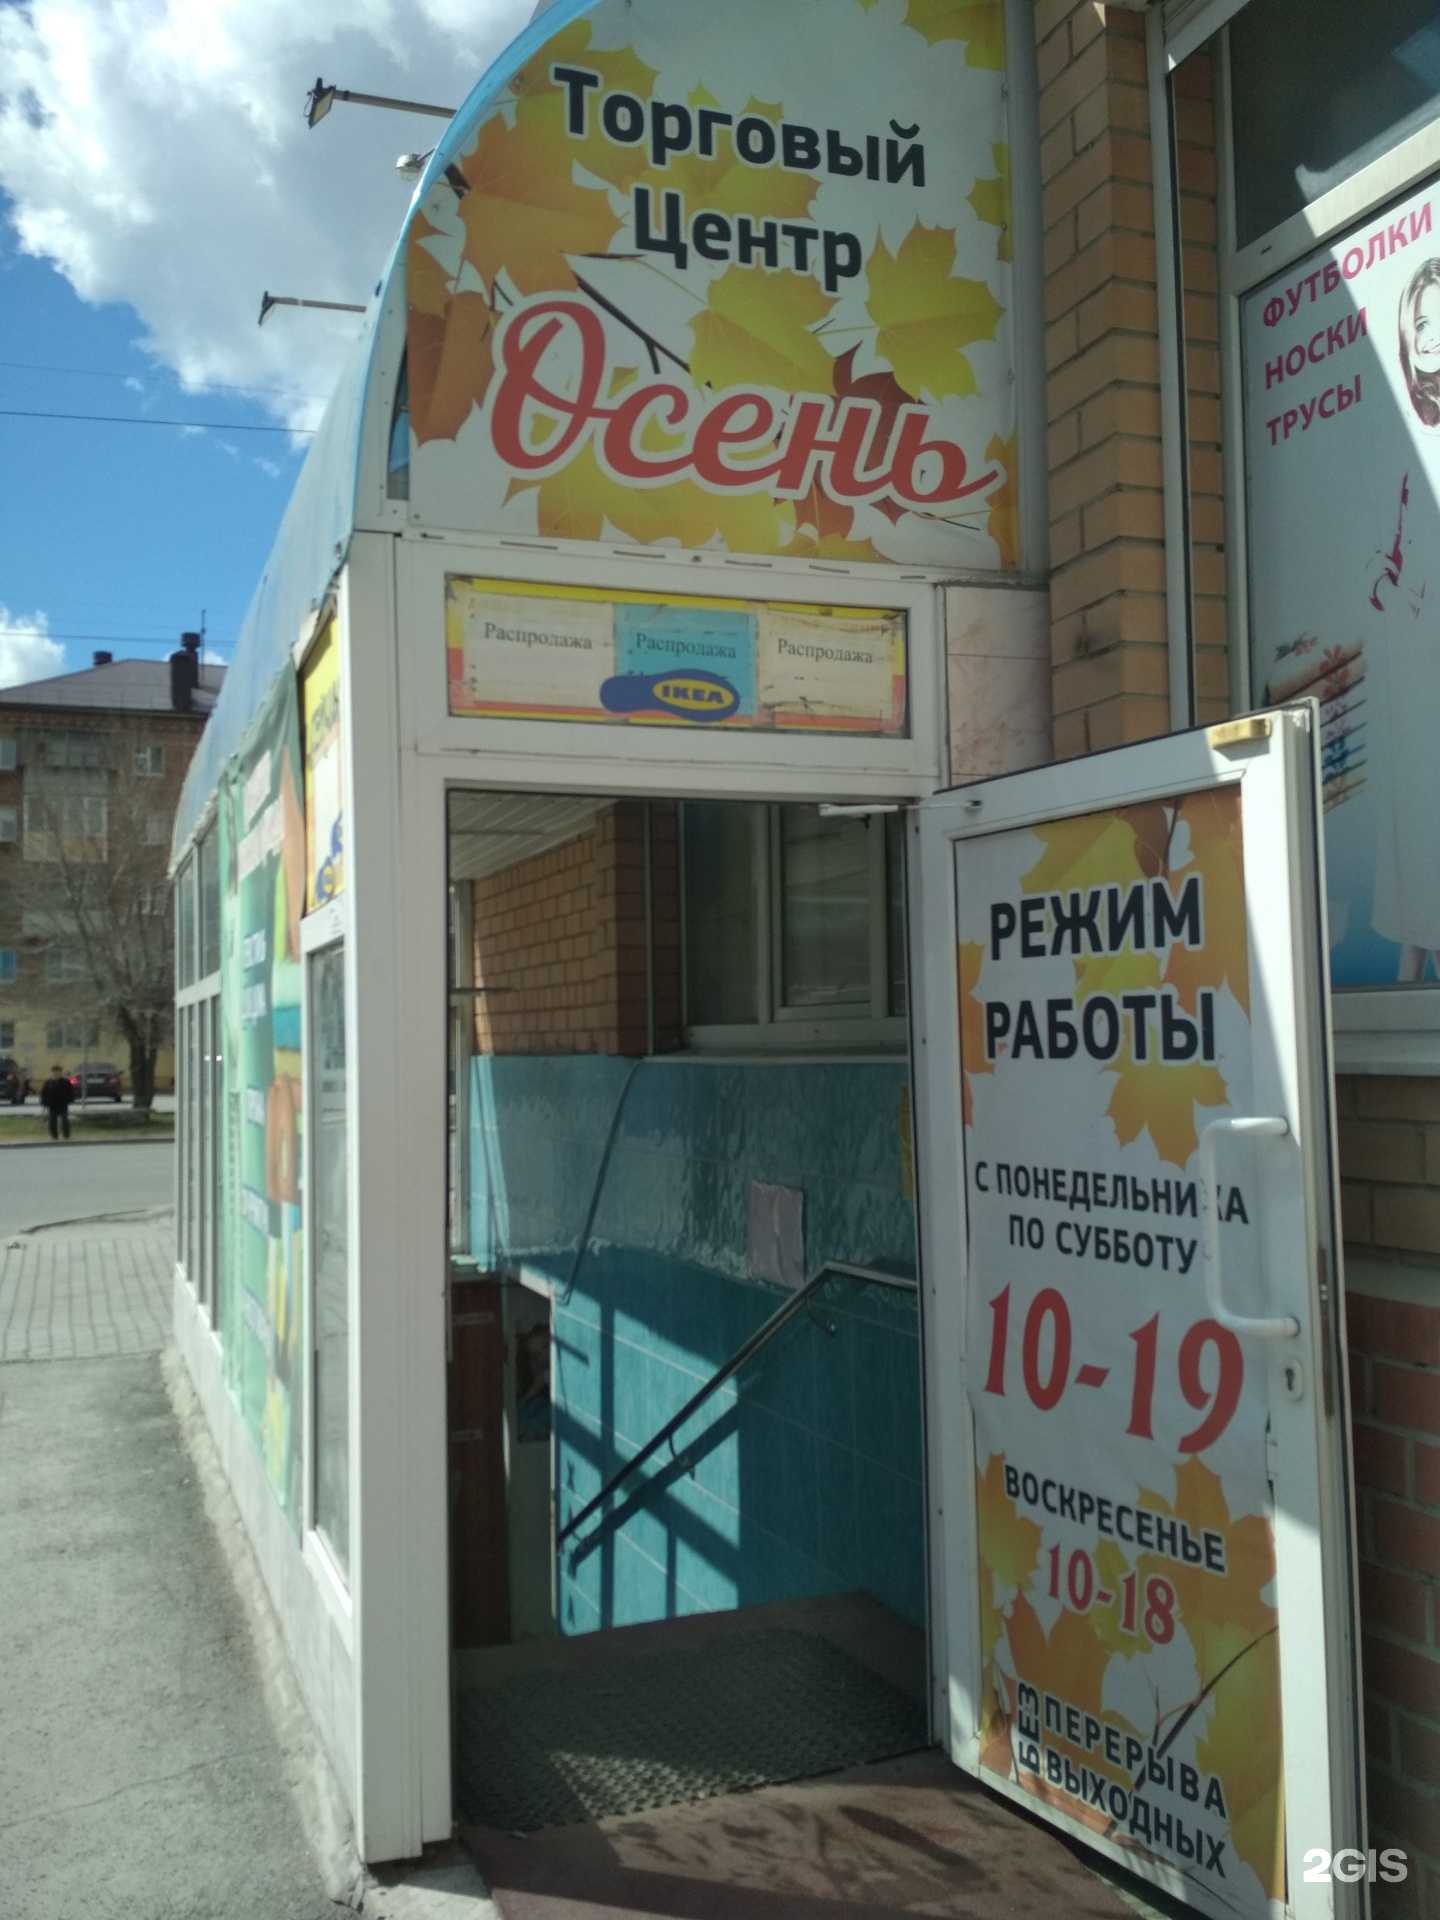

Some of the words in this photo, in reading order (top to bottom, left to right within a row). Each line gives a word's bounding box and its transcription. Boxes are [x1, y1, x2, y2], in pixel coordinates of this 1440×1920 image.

[554, 67, 926, 187] Торговый
[634, 187, 862, 292] Центр
[1262, 202, 1433, 328] ФУТБОЛКИ
[1264, 307, 1368, 390] НОСКИ
[490, 300, 1000, 502] Осень
[1266, 374, 1362, 446] ТРУСЫ
[484, 622, 592, 649] Распродажа
[635, 632, 737, 659] Распродажа
[777, 638, 873, 664] Распродажа
[661, 684, 726, 705] IKEA
[990, 877, 1201, 960] РЕЖИМ
[985, 992, 1215, 1061] РАБОТЫ
[975, 1161, 989, 1193] С
[1009, 1214, 1044, 1249] ПО
[1055, 1221, 1198, 1275] СУББОТУ
[984, 1282, 1244, 1454] 10-19
[1005, 1464, 1226, 1574] ВОСКРЕСЕНЬЕ
[1048, 1543, 1177, 1645] 10-18
[1018, 1683, 1040, 1775] БЕЗ
[1045, 1695, 1227, 1819] ПЕРЕРЫВА
[1046, 1749, 1226, 1879] ВЫХОДНЫХ
